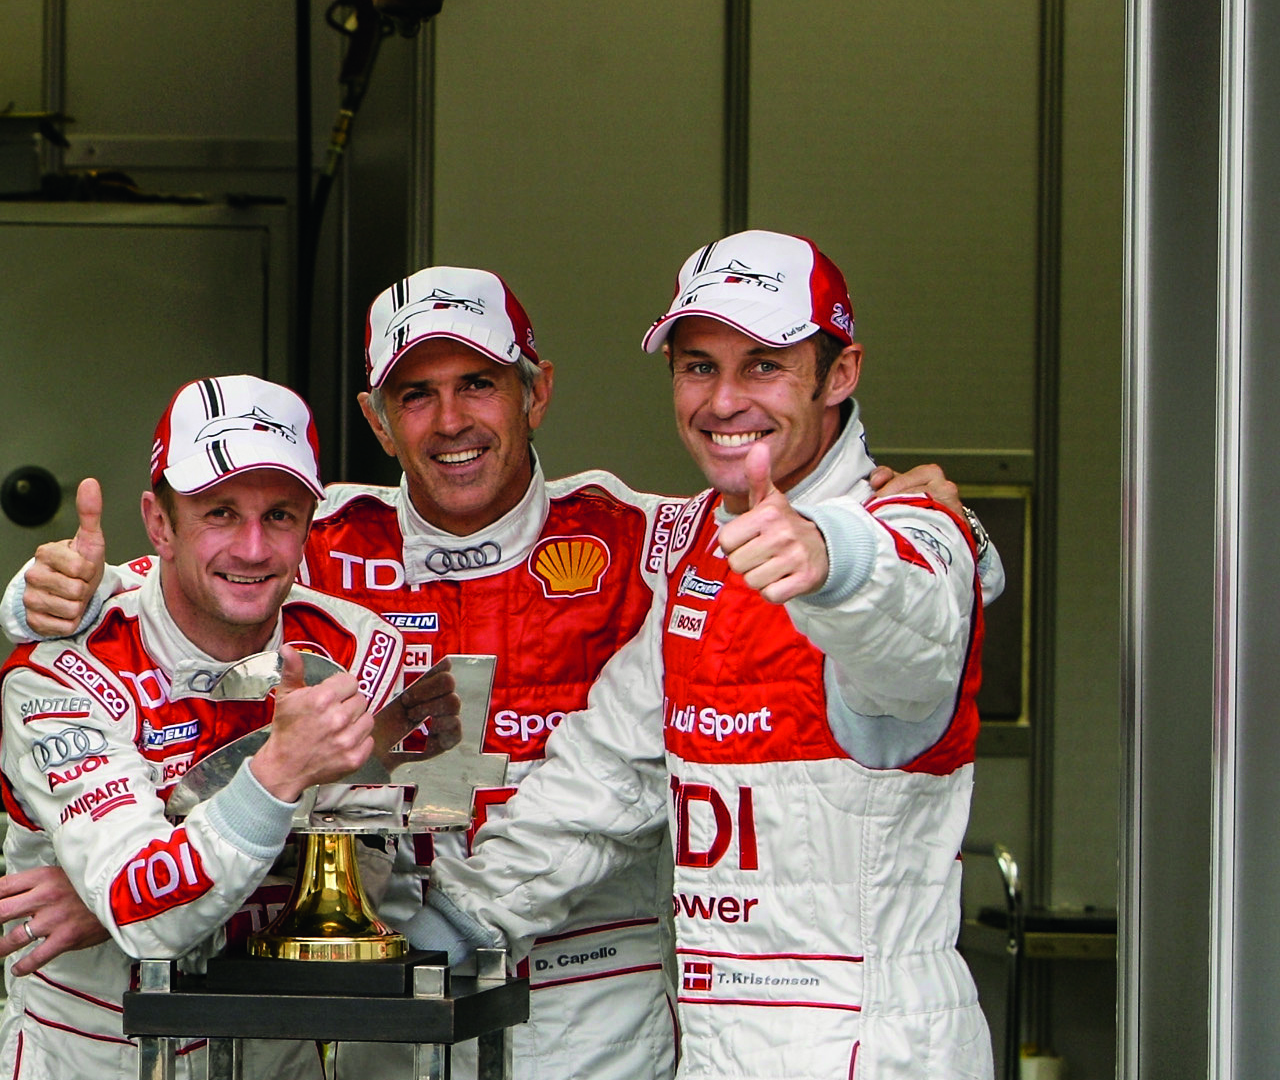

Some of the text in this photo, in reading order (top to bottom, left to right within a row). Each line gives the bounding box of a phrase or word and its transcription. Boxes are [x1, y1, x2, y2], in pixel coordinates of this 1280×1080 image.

[650, 504, 676, 570] sparco
[330, 550, 421, 592] TD
[386, 616, 435, 627] ELIN
[61, 653, 128, 714] sparco
[358, 633, 389, 699] parco
[20, 698, 92, 718] SANDTLER
[494, 710, 564, 742] Spo
[698, 706, 772, 741] Sport
[47, 755, 110, 793] Audi
[60, 777, 131, 825] UNIPART
[127, 841, 198, 904] TDI
[535, 946, 617, 971] D. Capello
